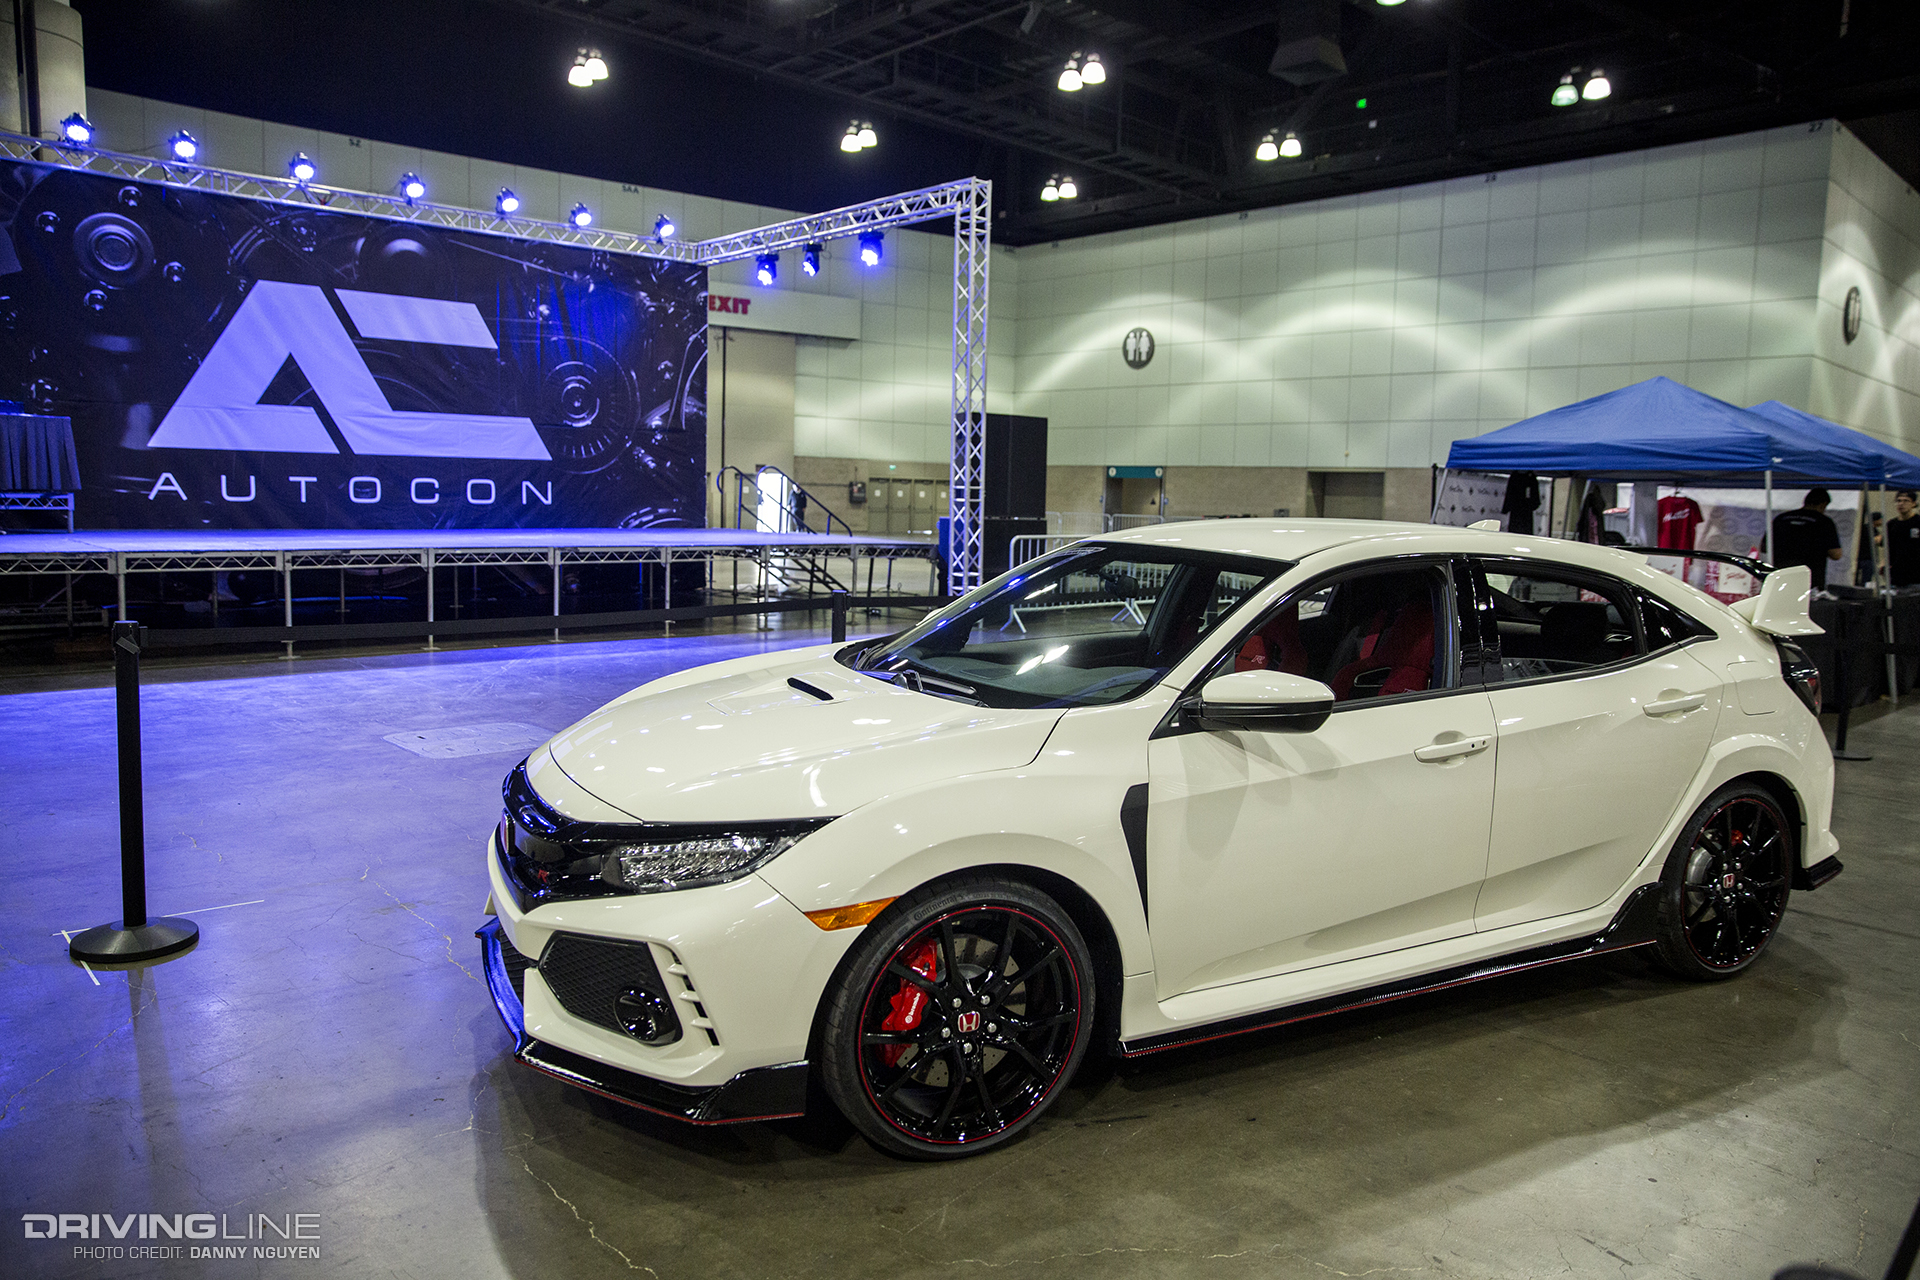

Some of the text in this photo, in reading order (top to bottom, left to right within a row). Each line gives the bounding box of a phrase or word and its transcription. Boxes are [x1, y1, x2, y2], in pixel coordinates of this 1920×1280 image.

[708, 294, 751, 315] EXIT
[148, 472, 552, 505] AUTOCON
[914, 895, 957, 921] Continental
